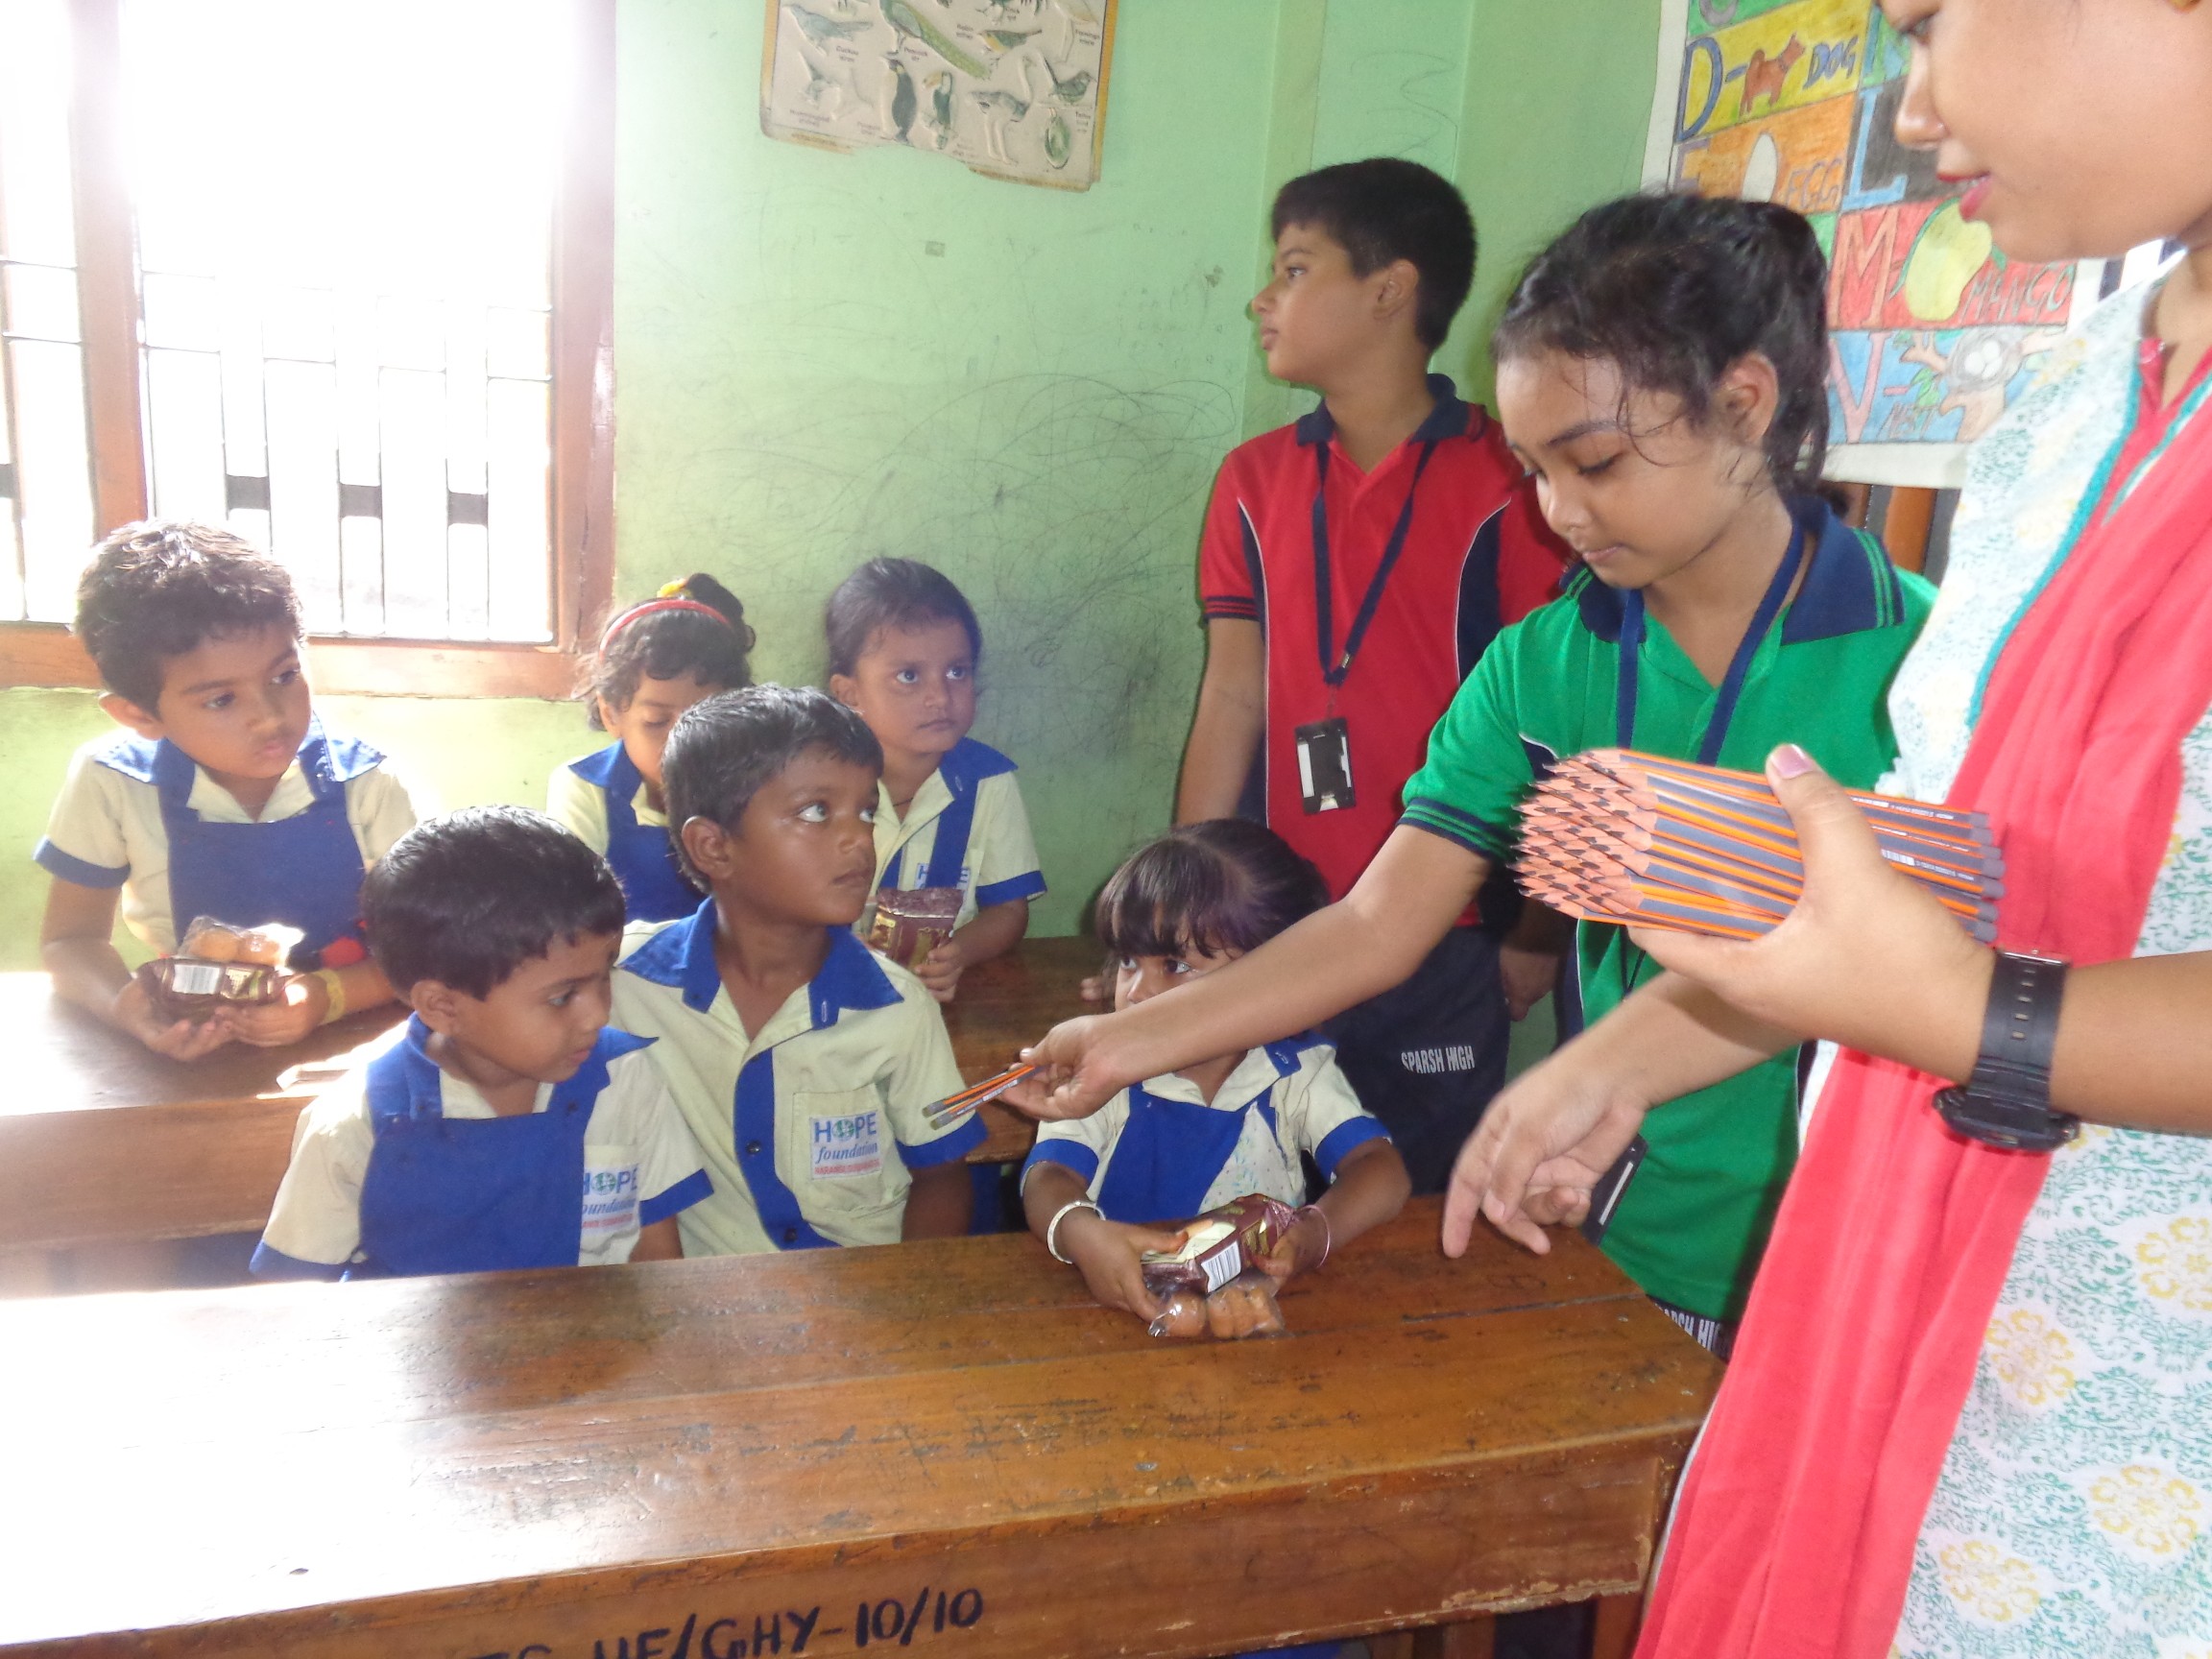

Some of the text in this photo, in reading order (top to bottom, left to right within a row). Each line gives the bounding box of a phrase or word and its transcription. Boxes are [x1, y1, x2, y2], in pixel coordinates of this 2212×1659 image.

[1802, 35, 1859, 89] DOG
[1401, 1047, 1446, 1074] SPARSH
[814, 1112, 878, 1142] HOPE
